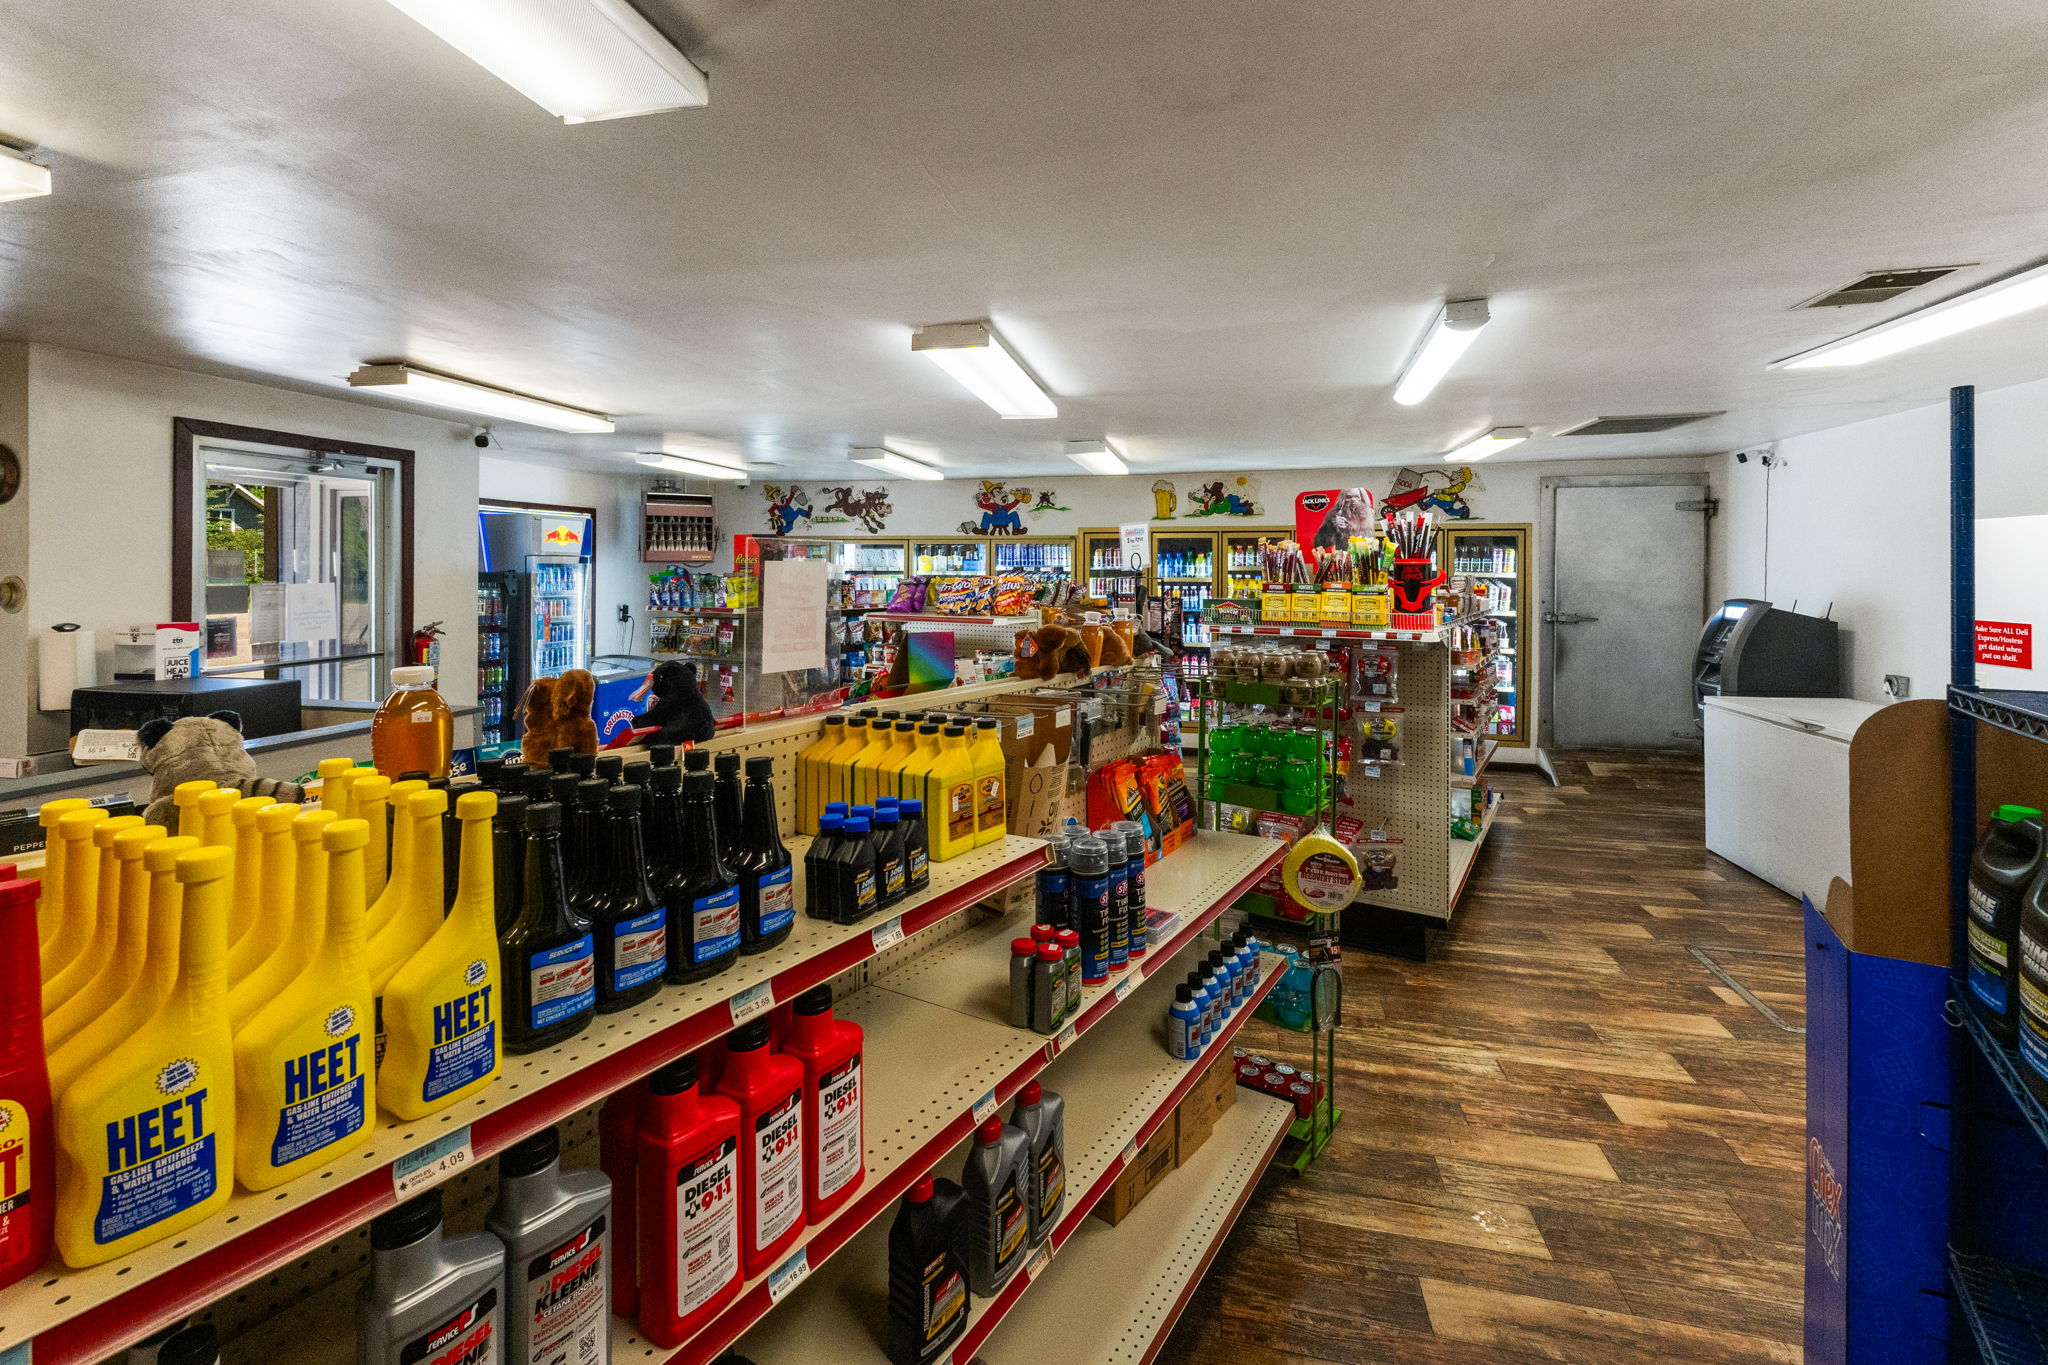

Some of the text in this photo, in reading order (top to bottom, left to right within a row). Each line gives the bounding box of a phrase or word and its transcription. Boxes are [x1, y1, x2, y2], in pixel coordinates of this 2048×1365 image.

[1398, 478, 1413, 488] SODA
[1403, 564, 1420, 572] JACK
[1977, 633, 2023, 645] Express/Hostess
[2002, 627, 2014, 635] ALL
[2016, 628, 2029, 636] Deli
[1978, 643, 2023, 653] get dated when
[166, 658, 189, 667] JUICE
[166, 667, 189, 675] HEAD
[13, 840, 47, 852] PEPPE
[1300, 872, 1352, 886] RECOVERY STRAP
[433, 984, 492, 1045] HEET
[285, 1033, 360, 1105] HEET
[286, 1079, 357, 1116] GAS-LINE ANTIFREEZE
[824, 1076, 857, 1106] DIESEL
[296, 1106, 320, 1121] WATER
[322, 1090, 352, 1111] REMOVER
[106, 1088, 207, 1172] HEET
[761, 1113, 798, 1149] DIESEL
[110, 1140, 204, 1185] GAS-LINE ANTIFREEZE
[111, 1153, 197, 1195] & WATER REMOVER
[439, 1151, 464, 1171] 4.09
[684, 1162, 731, 1204] DIESEL
[1810, 1136, 1842, 1224] Chex
[549, 1246, 576, 1269] SERVICE
[551, 1242, 602, 1291] DIESEL
[790, 1263, 807, 1281] 16.99
[535, 1260, 597, 1315] KLEEN
[426, 1327, 459, 1353] SERVICE
